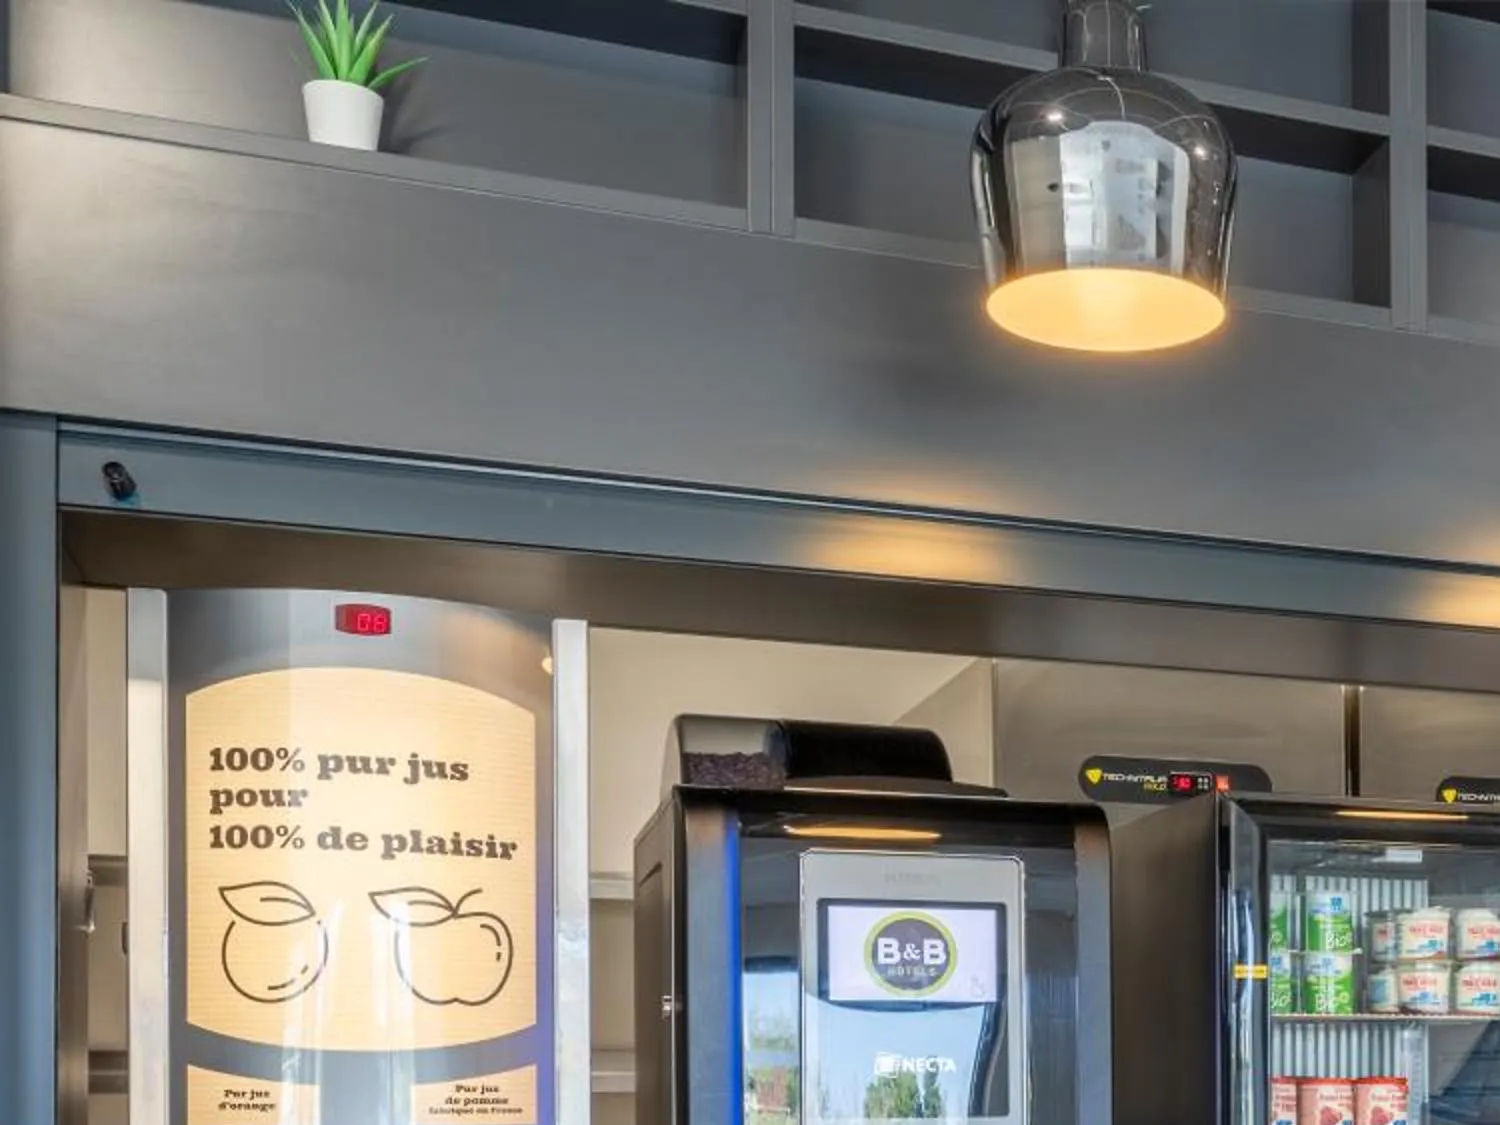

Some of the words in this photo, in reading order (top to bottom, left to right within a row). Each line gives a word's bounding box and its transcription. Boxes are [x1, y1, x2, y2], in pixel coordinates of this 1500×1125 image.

[209, 747, 305, 772] 100%
[316, 753, 396, 781] pur
[403, 752, 469, 785] jus
[209, 787, 308, 815] pour
[209, 824, 305, 850] 100%
[316, 826, 369, 850] de
[380, 829, 518, 861] plaisir
[887, 965, 938, 977] HOTELS
[901, 1056, 957, 1073] NECTA
[223, 1088, 247, 1098] Pur
[249, 1089, 270, 1100] jus
[218, 1101, 276, 1112] d'orange
